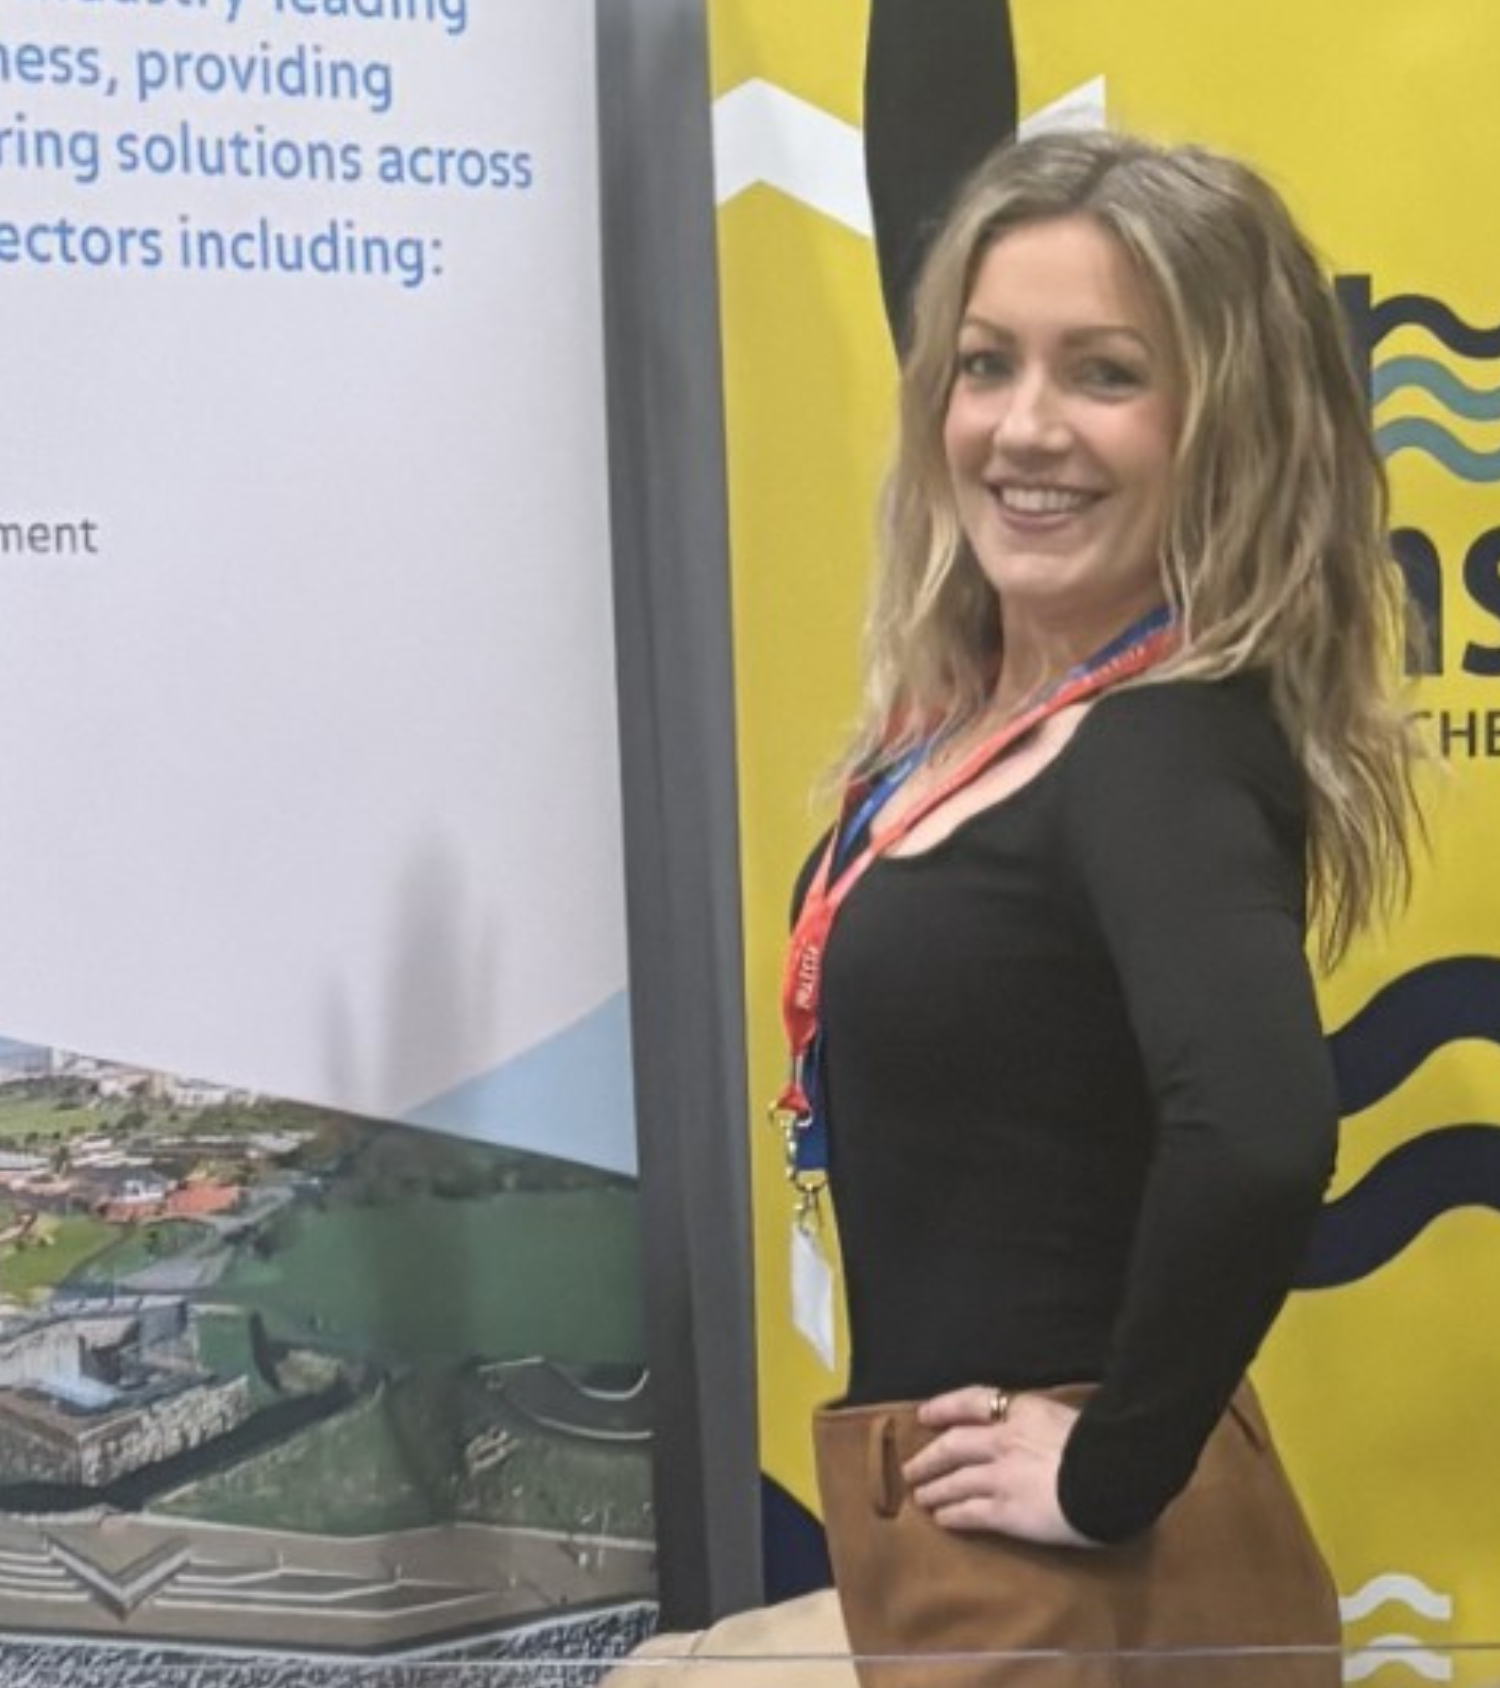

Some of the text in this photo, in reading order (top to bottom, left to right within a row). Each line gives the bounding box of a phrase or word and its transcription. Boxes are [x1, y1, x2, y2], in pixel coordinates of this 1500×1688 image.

[137, 42, 393, 113] providing
[116, 121, 363, 182] solutions
[378, 145, 534, 189] across
[180, 215, 443, 288] including:
